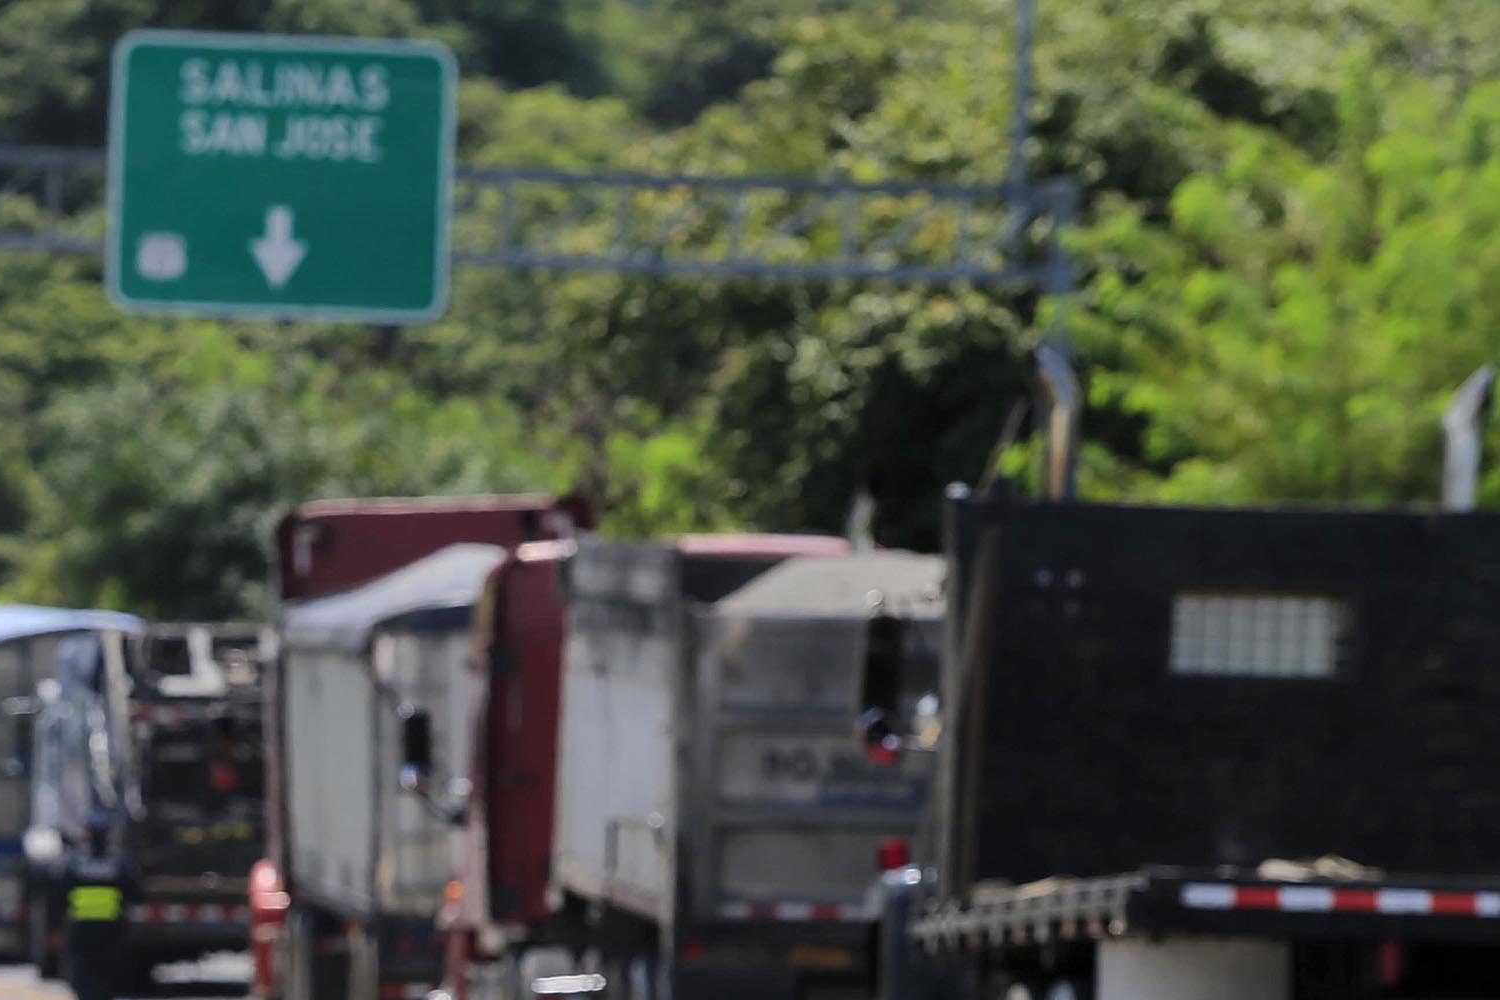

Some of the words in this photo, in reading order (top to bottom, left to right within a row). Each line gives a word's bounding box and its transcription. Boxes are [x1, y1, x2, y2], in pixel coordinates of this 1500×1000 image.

[181, 60, 389, 109] SALINAS
[182, 110, 267, 155] SAN
[273, 114, 381, 162] JOSE
